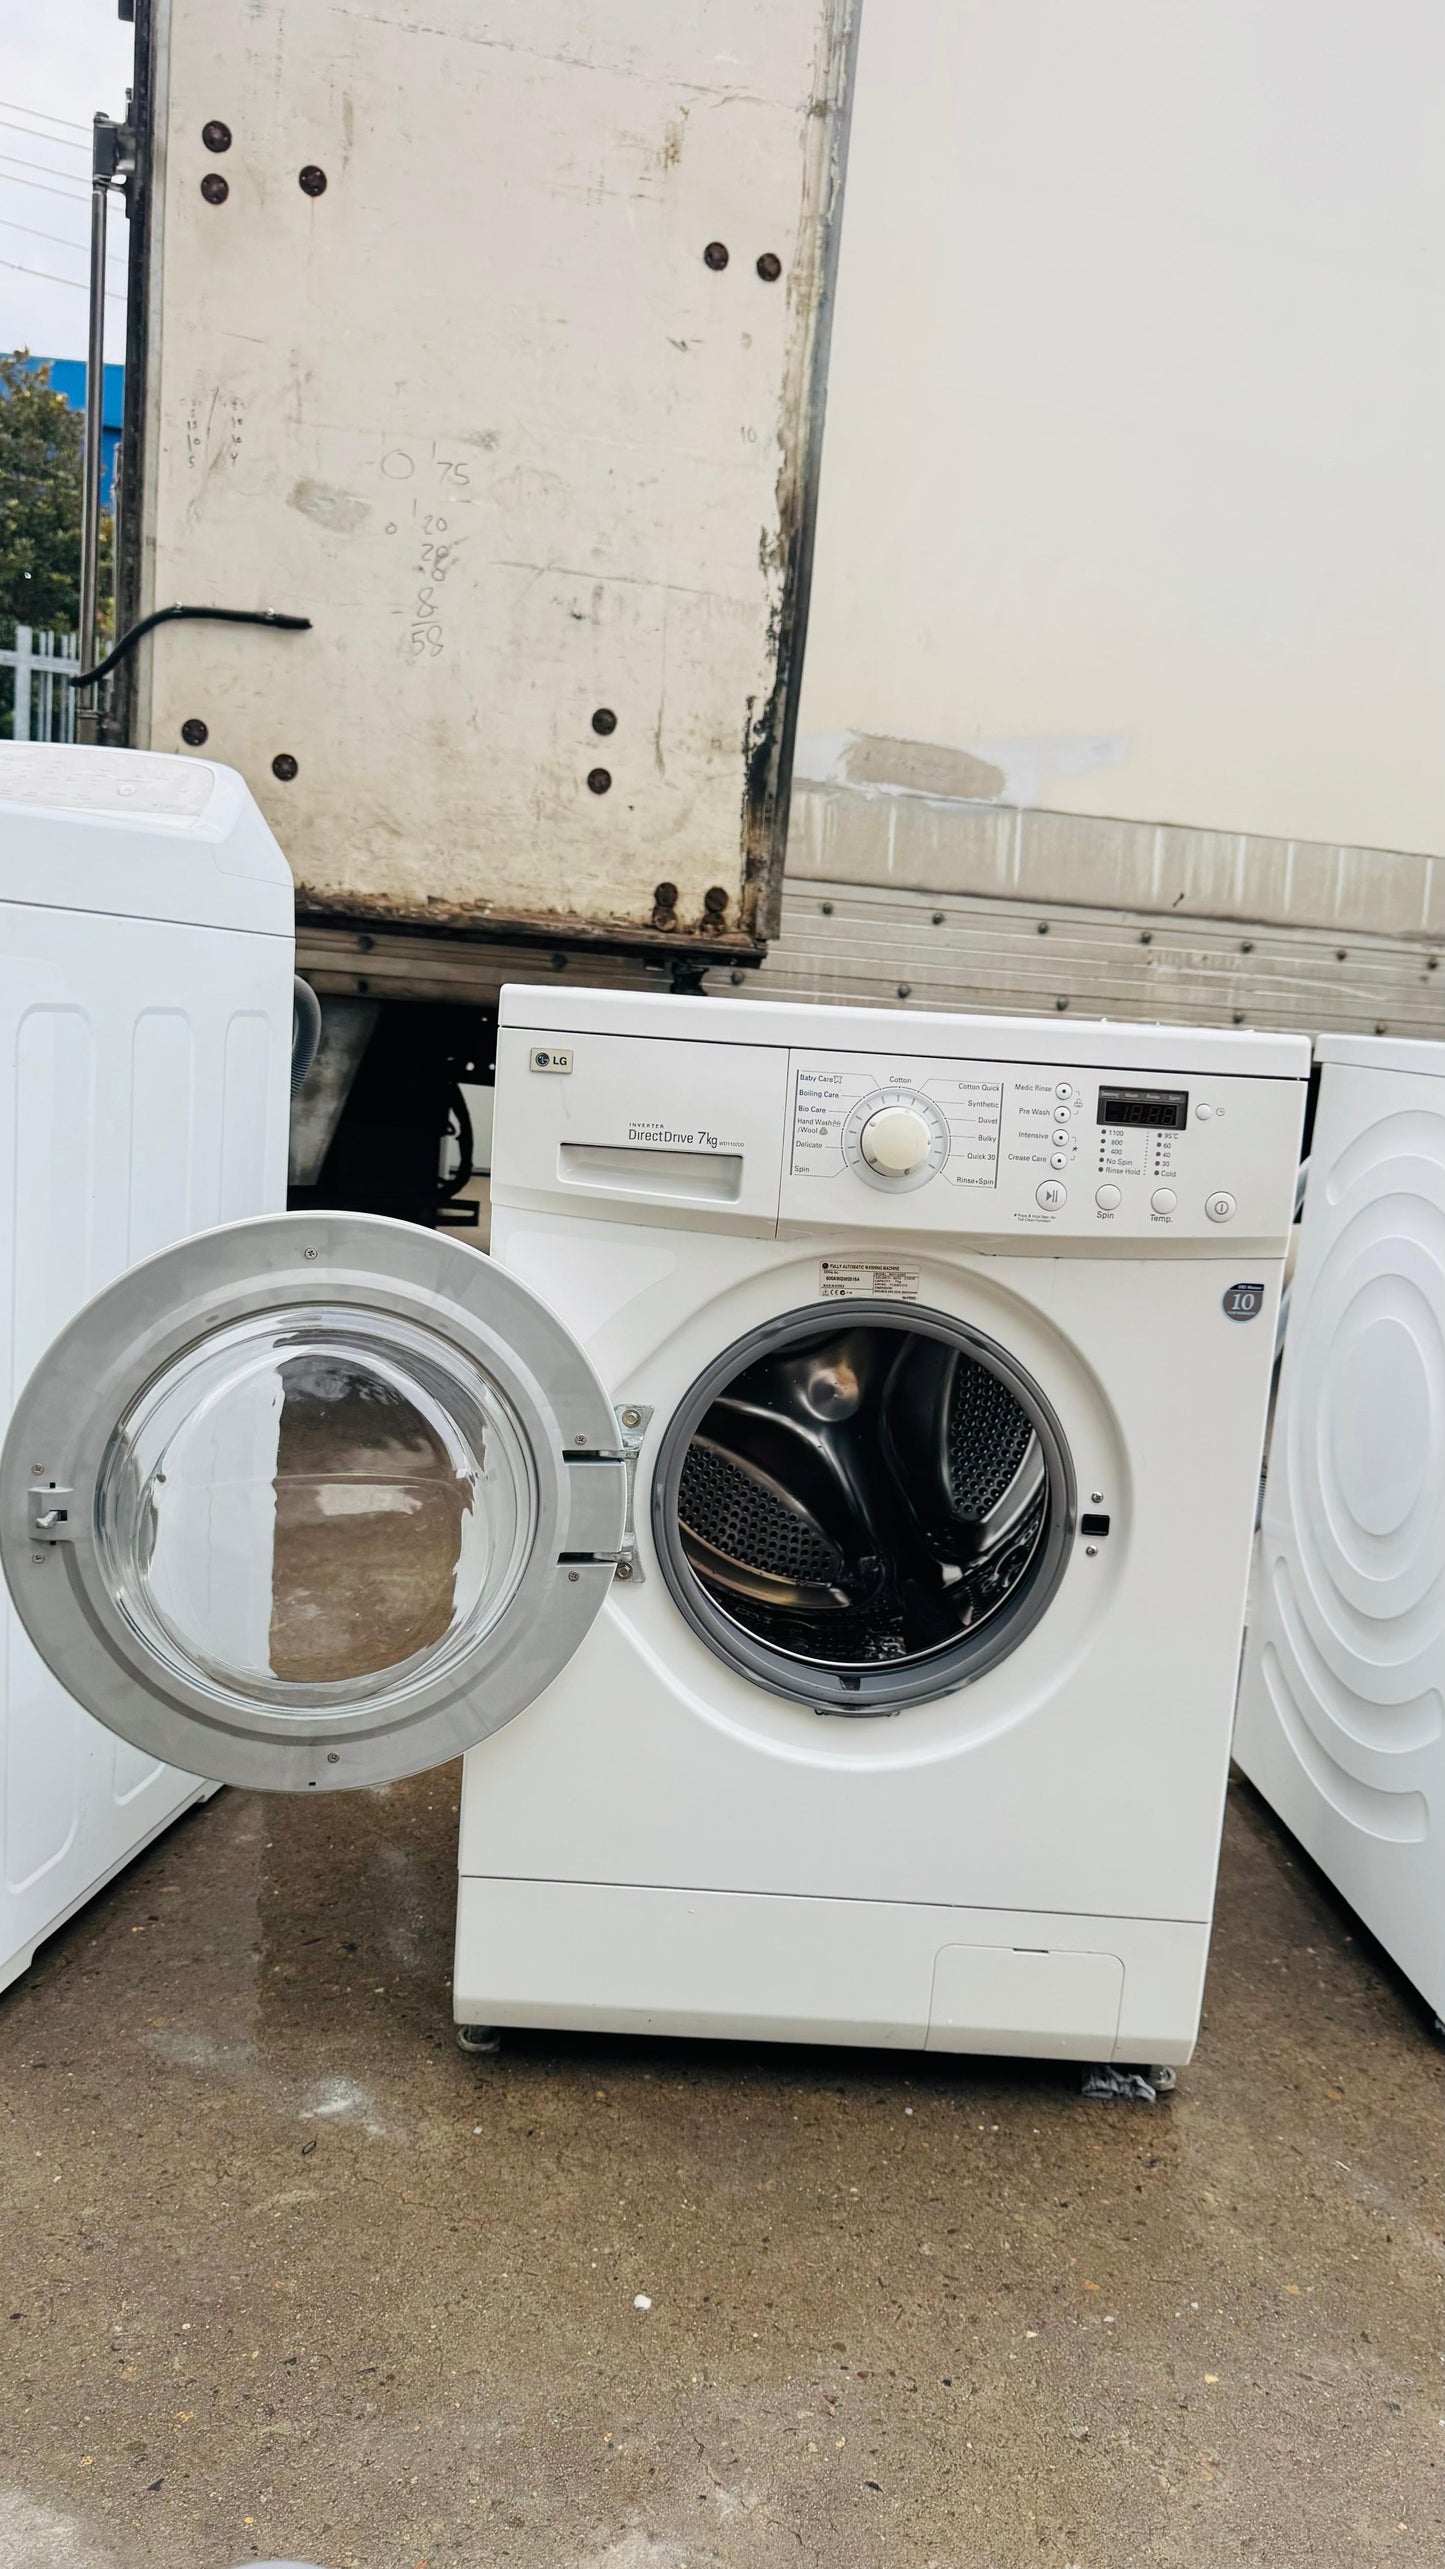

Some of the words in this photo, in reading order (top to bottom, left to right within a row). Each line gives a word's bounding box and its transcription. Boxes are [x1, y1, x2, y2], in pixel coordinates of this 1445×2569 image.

[437, 461, 470, 486] 75
[423, 514, 448, 535] 20
[416, 586, 439, 619] 8
[411, 624, 444, 658] 58
[553, 1056, 567, 1066] LG
[800, 1074, 816, 1083] Baby
[818, 1075, 834, 1083] Care
[889, 1076, 912, 1084] Cotton
[799, 1089, 823, 1098] Boiling
[967, 1100, 999, 1108] Synthetic
[978, 1117, 998, 1125] Duvet
[978, 1135, 997, 1143] Bulky
[1018, 1131, 1049, 1139] Intensive
[697, 1131, 718, 1149] 7kg
[796, 1140, 823, 1149] Delicate
[794, 1165, 810, 1173] Spin
[1096, 1211, 1115, 1220] Spin
[1150, 1214, 1174, 1223] Temp.
[1231, 1293, 1255, 1310] 10
